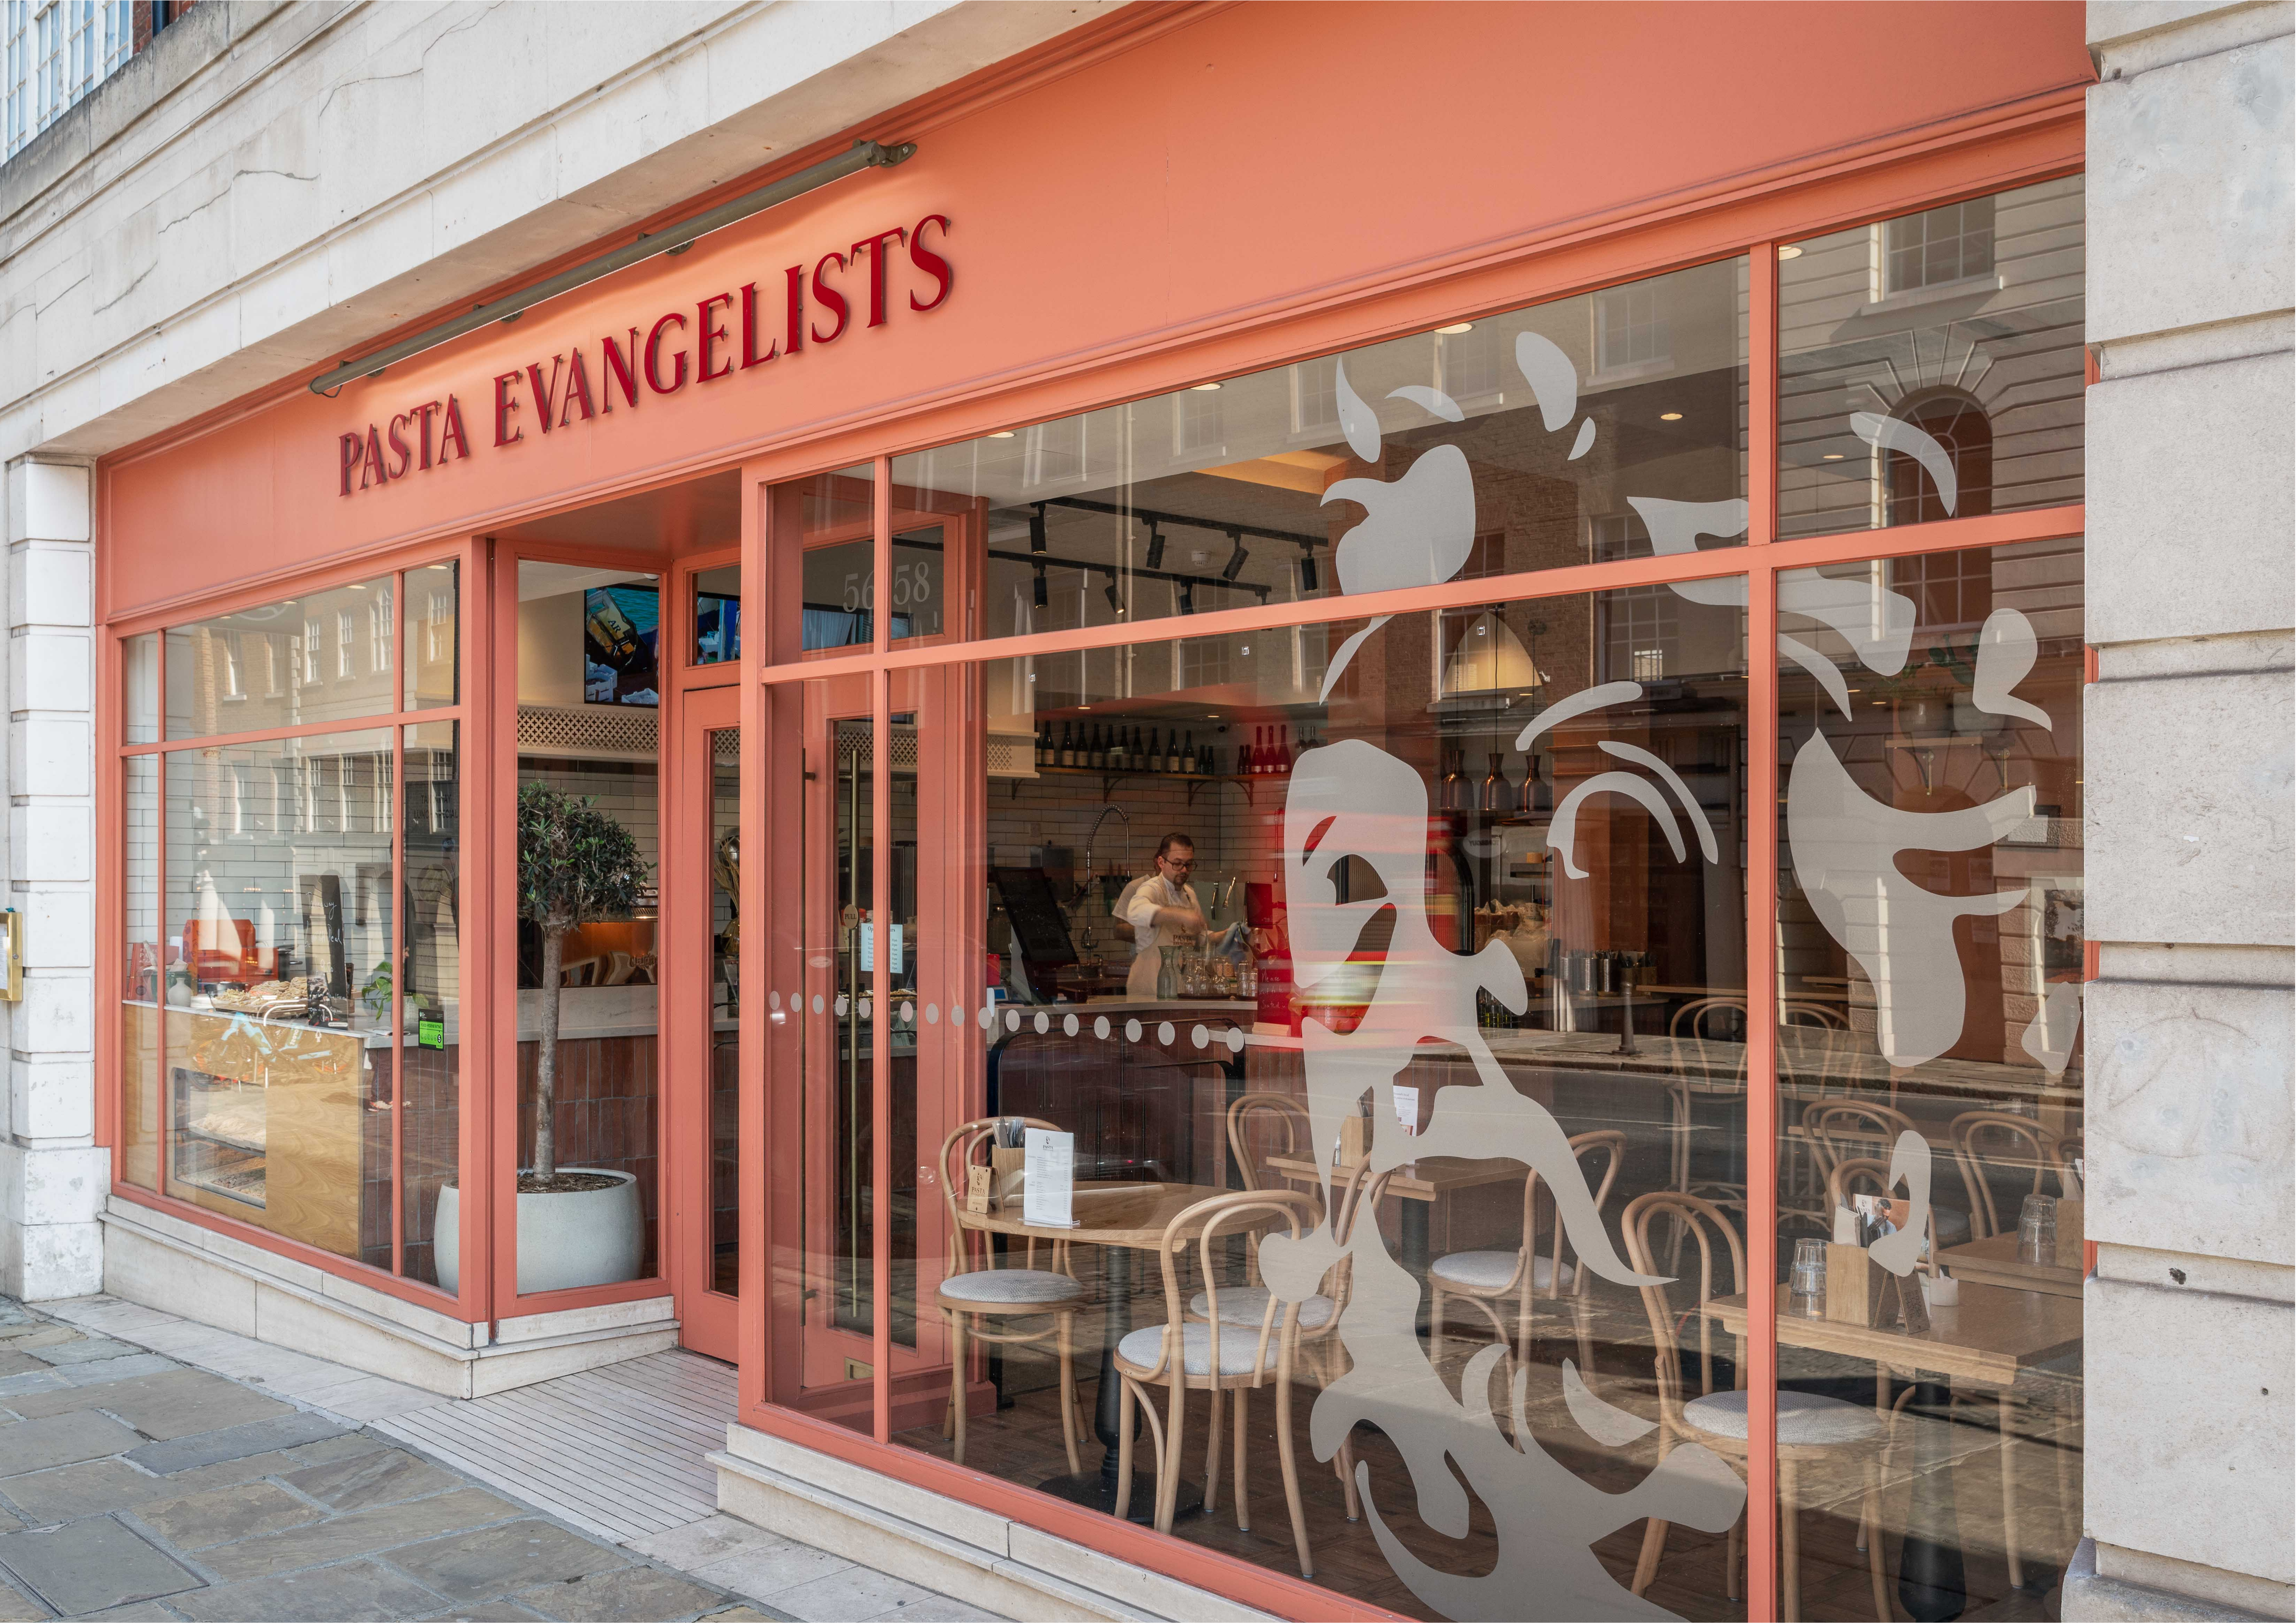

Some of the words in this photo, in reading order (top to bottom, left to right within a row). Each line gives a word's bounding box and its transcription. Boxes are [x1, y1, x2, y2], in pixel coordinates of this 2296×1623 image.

[339, 392, 469, 497] PASTA
[493, 214, 953, 448] EVANGELISTS
[972, 1186, 985, 1195] PASTA
